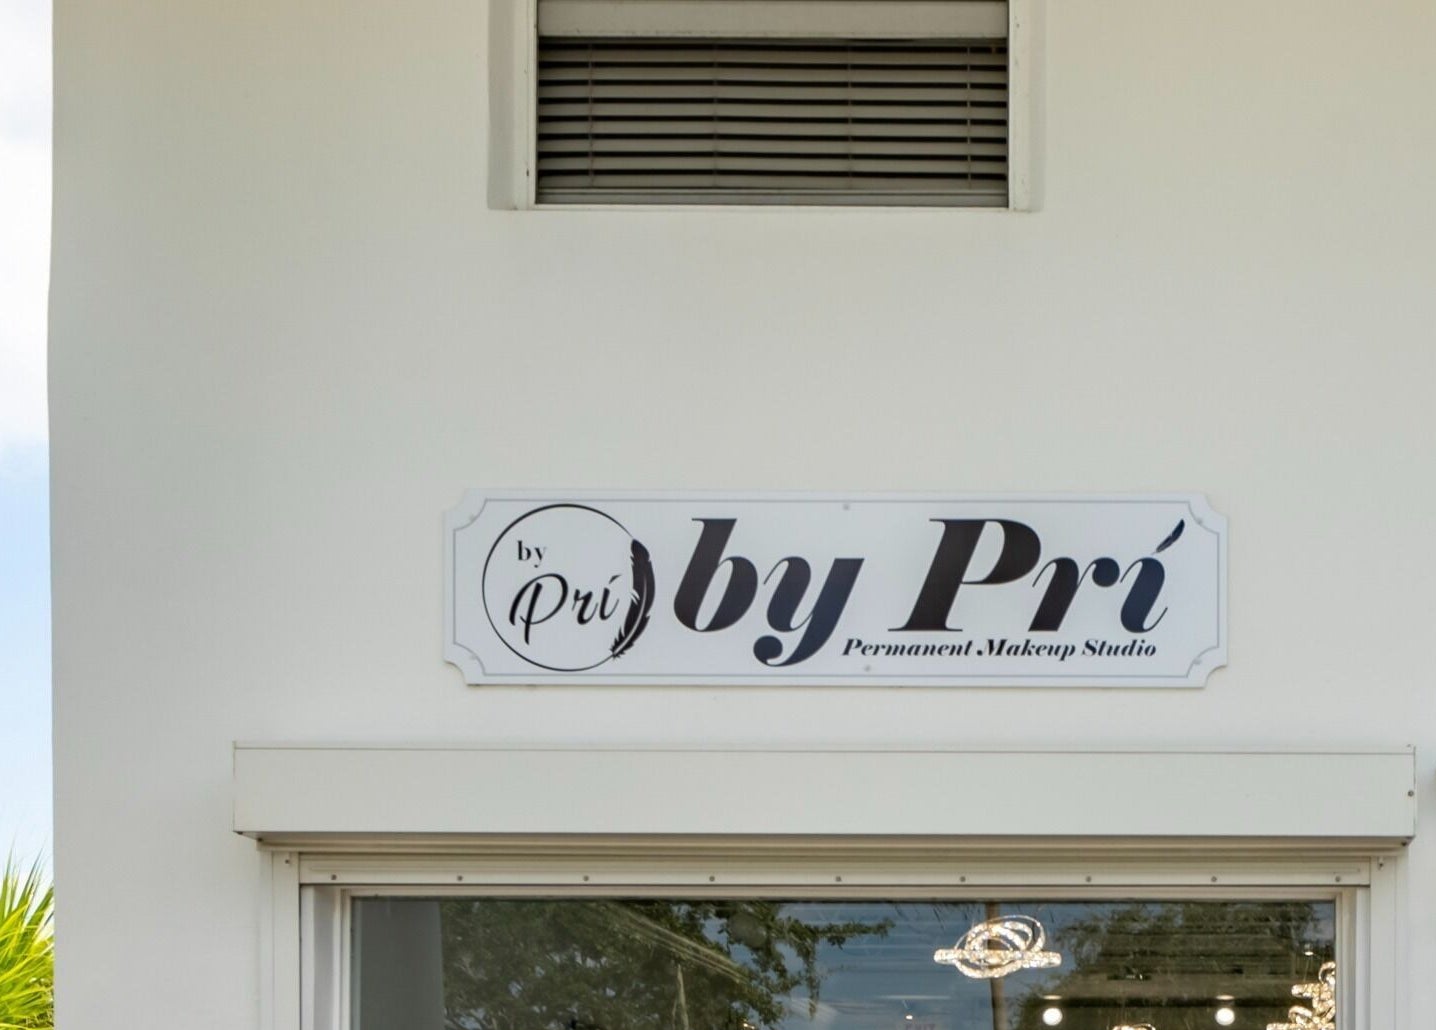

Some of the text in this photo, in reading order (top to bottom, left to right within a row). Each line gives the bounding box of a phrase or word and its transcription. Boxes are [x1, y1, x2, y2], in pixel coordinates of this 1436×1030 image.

[516, 540, 548, 568] by
[509, 573, 623, 645] Prí
[673, 517, 1186, 667] by Prí
[841, 637, 1158, 661] Permanent Makeup Studio
